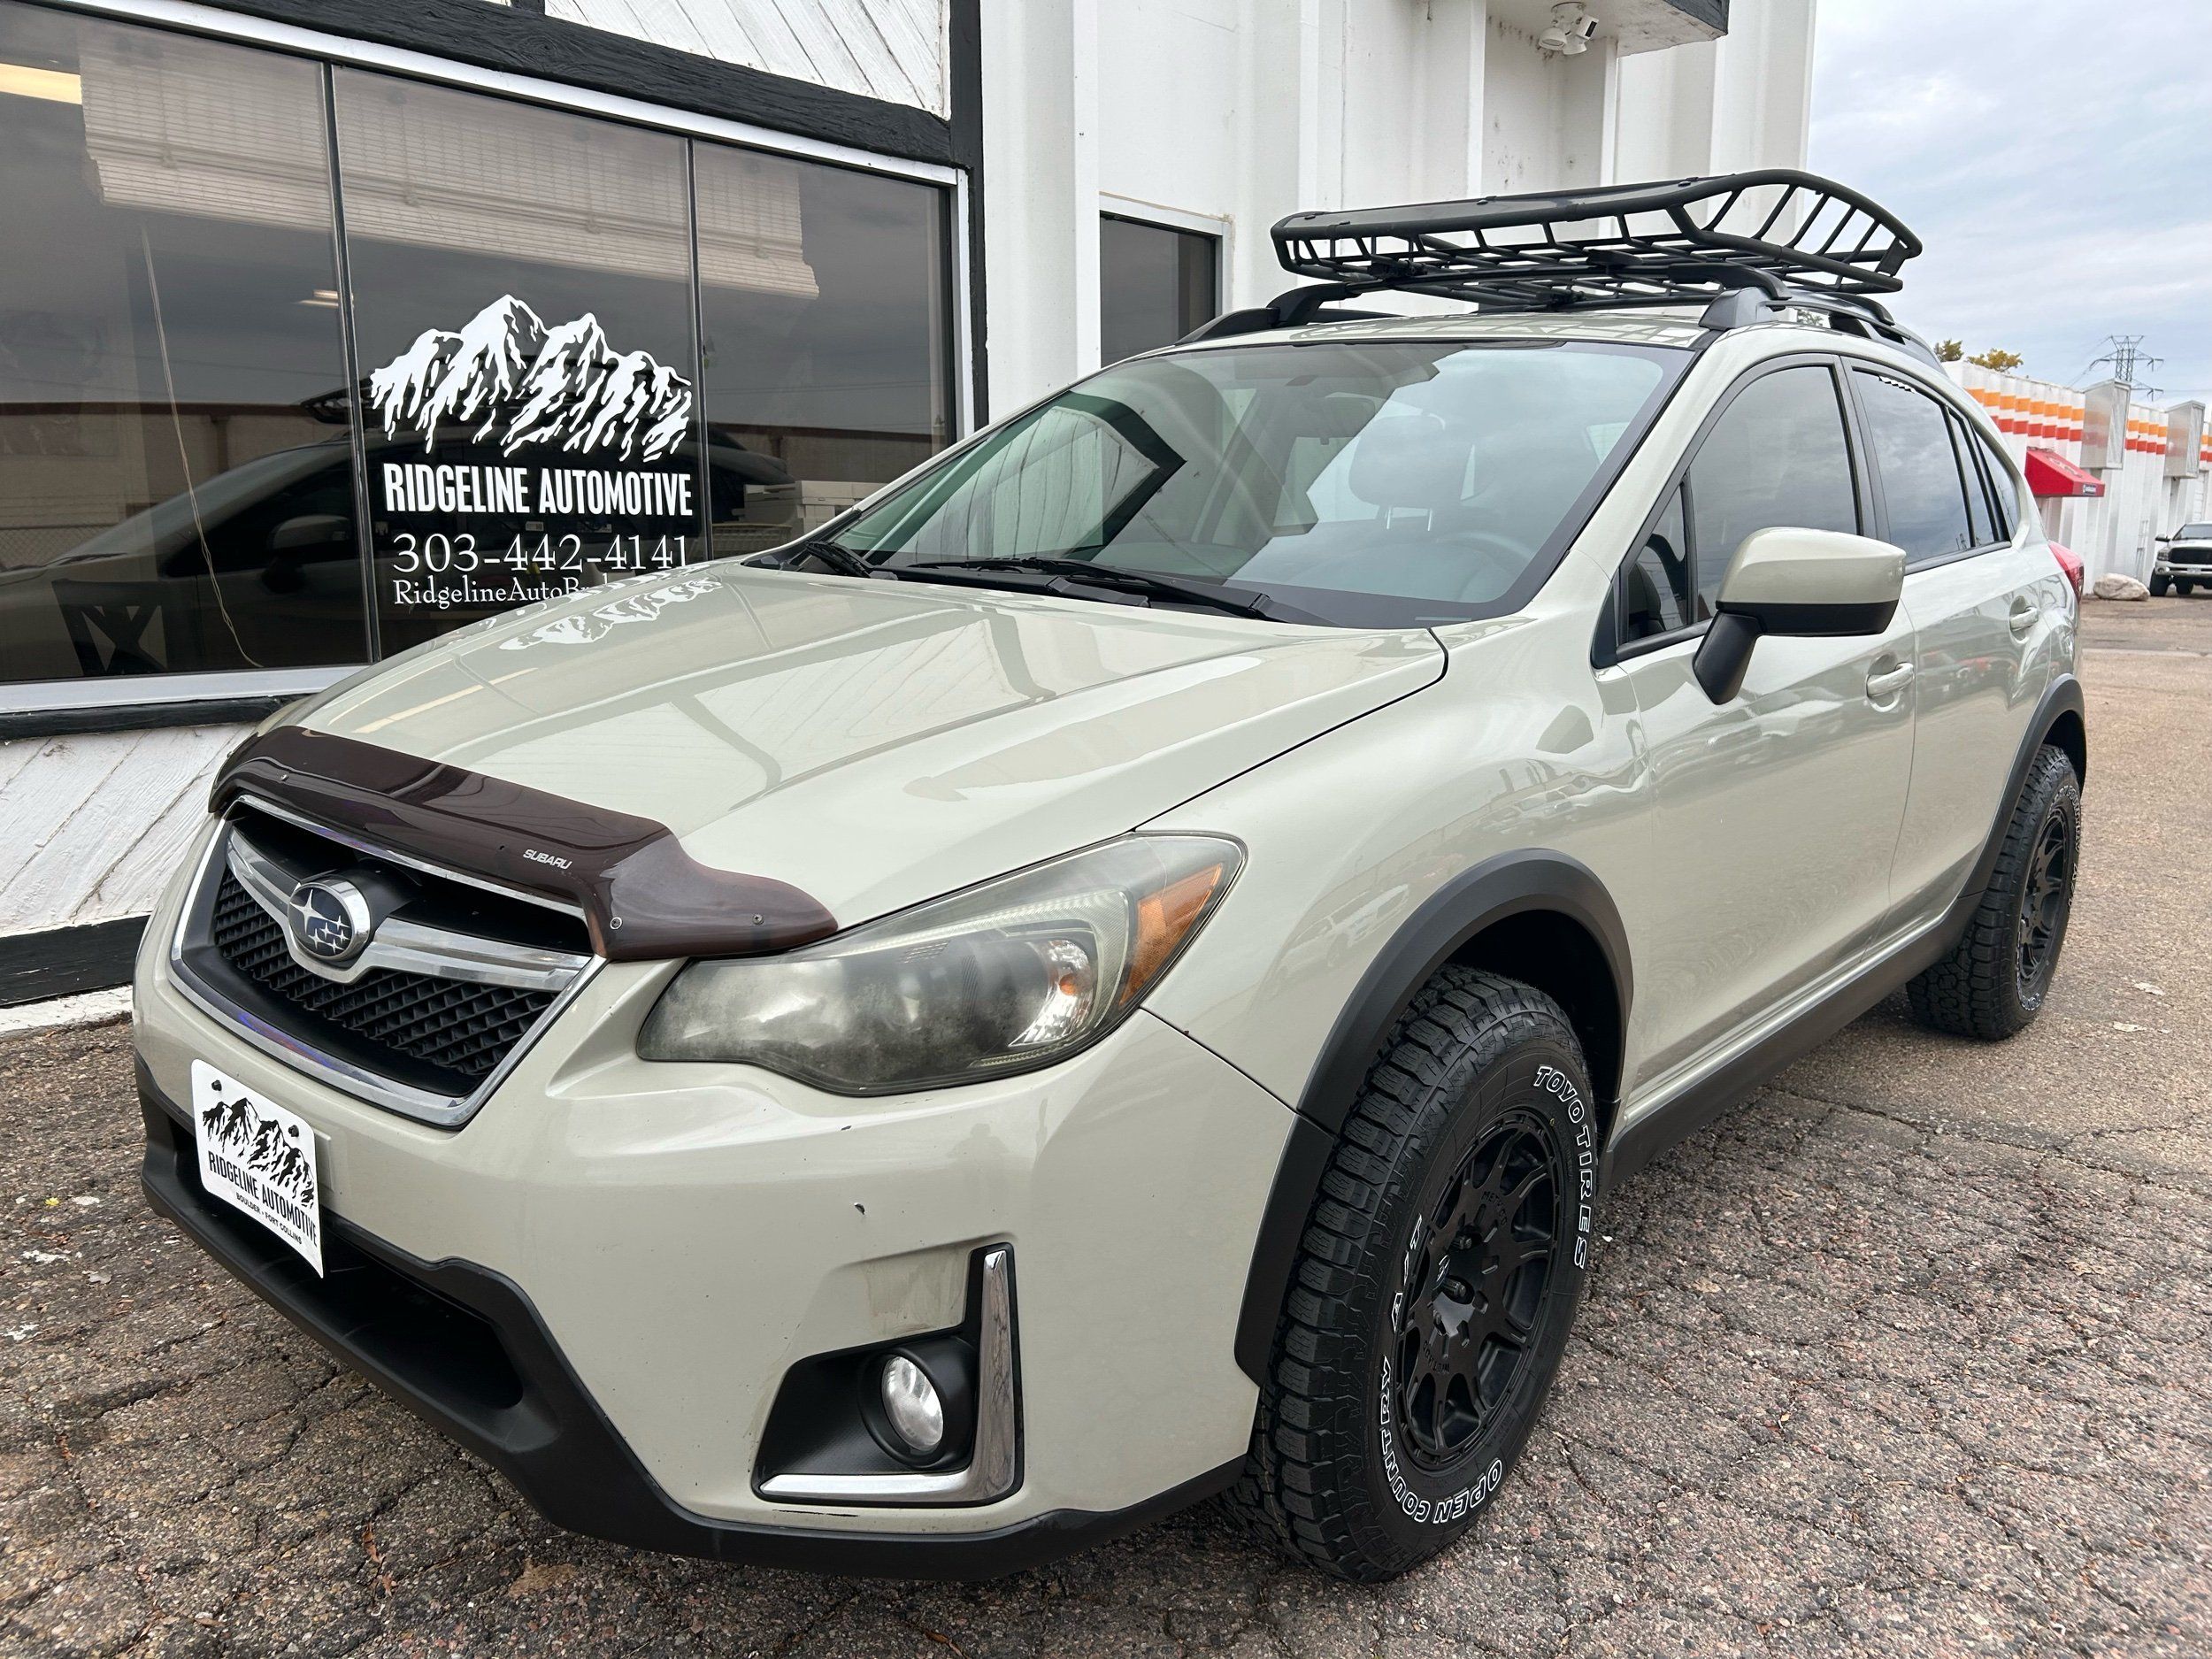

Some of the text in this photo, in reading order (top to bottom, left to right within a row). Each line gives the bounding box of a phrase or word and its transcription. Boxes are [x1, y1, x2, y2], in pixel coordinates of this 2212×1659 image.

[383, 463, 693, 516] RIDGELINE AUTOMOTIVE
[392, 533, 687, 572] 303-442-4141
[523, 849, 572, 870] SUBARU
[1533, 1065, 1584, 1124] TOYO
[1573, 1125, 1593, 1269] TIRES
[208, 1151, 317, 1248] RIDGELINE AUTOMOTIVE
[236, 1192, 302, 1245] BOULDER FORT COLLINS
[1380, 1355, 1431, 1523] COUNTRY
[1432, 1458, 1502, 1524] OPEN
